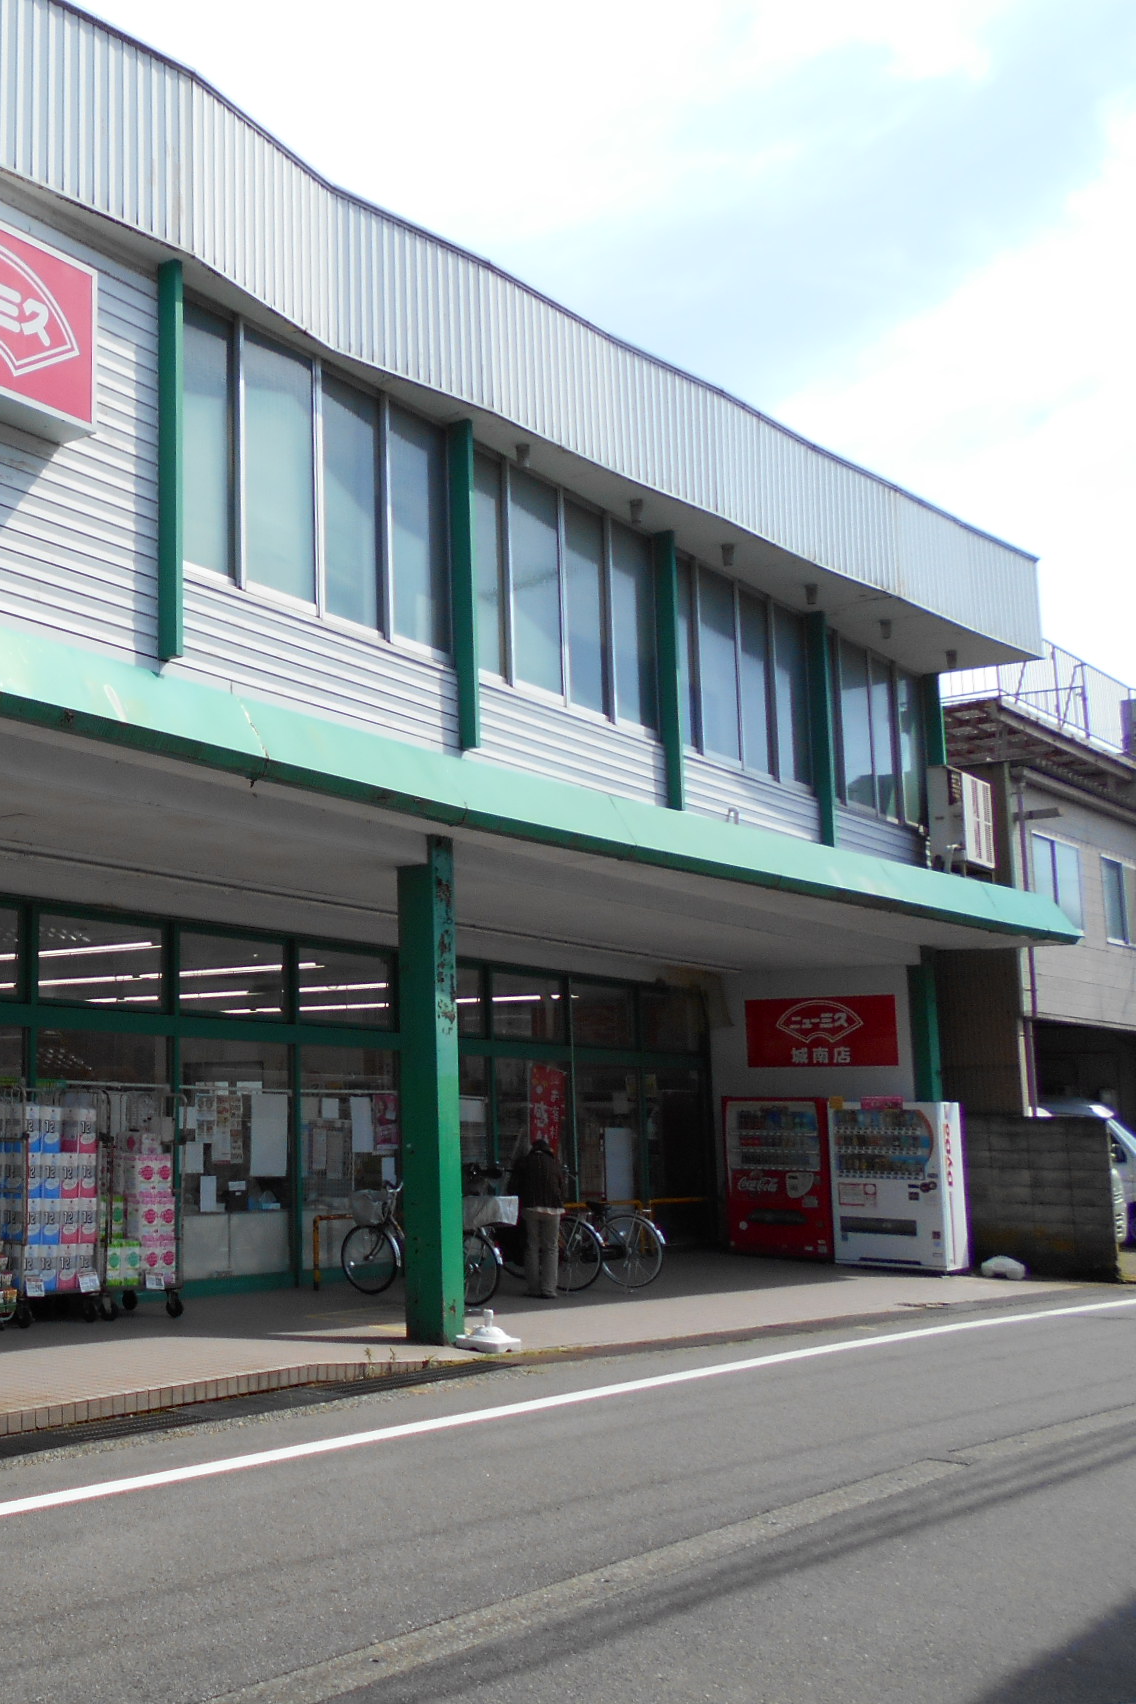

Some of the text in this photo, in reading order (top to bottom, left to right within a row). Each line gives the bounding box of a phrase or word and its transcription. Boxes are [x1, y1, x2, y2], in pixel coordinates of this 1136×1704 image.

[789, 1012, 849, 1029] ニューミス
[791, 1047, 851, 1064] 城南店
